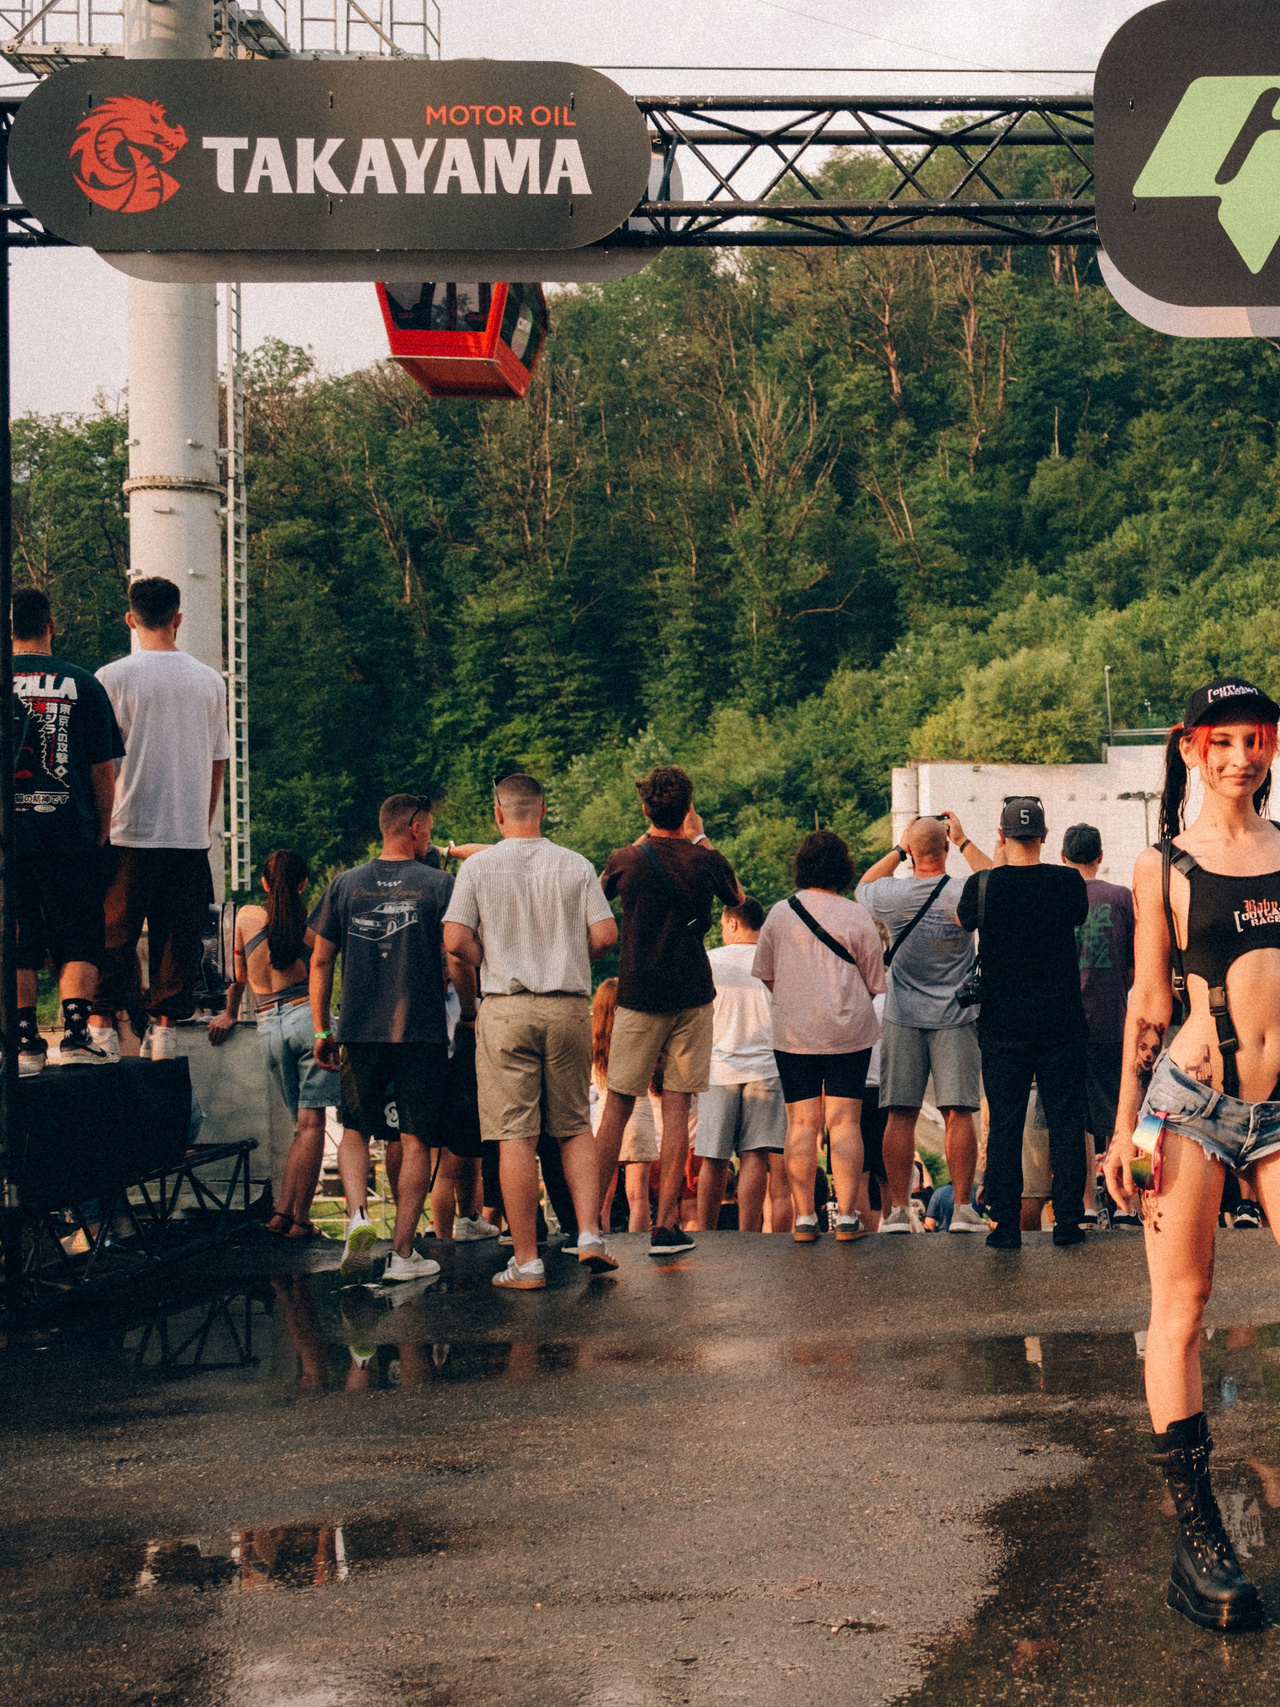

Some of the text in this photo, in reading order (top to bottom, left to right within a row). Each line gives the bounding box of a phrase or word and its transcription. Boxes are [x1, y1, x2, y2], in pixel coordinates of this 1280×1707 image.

[426, 104, 578, 127] MOTOR OIL
[202, 137, 593, 195] TAKAYAMA
[1020, 809, 1030, 825] 5
